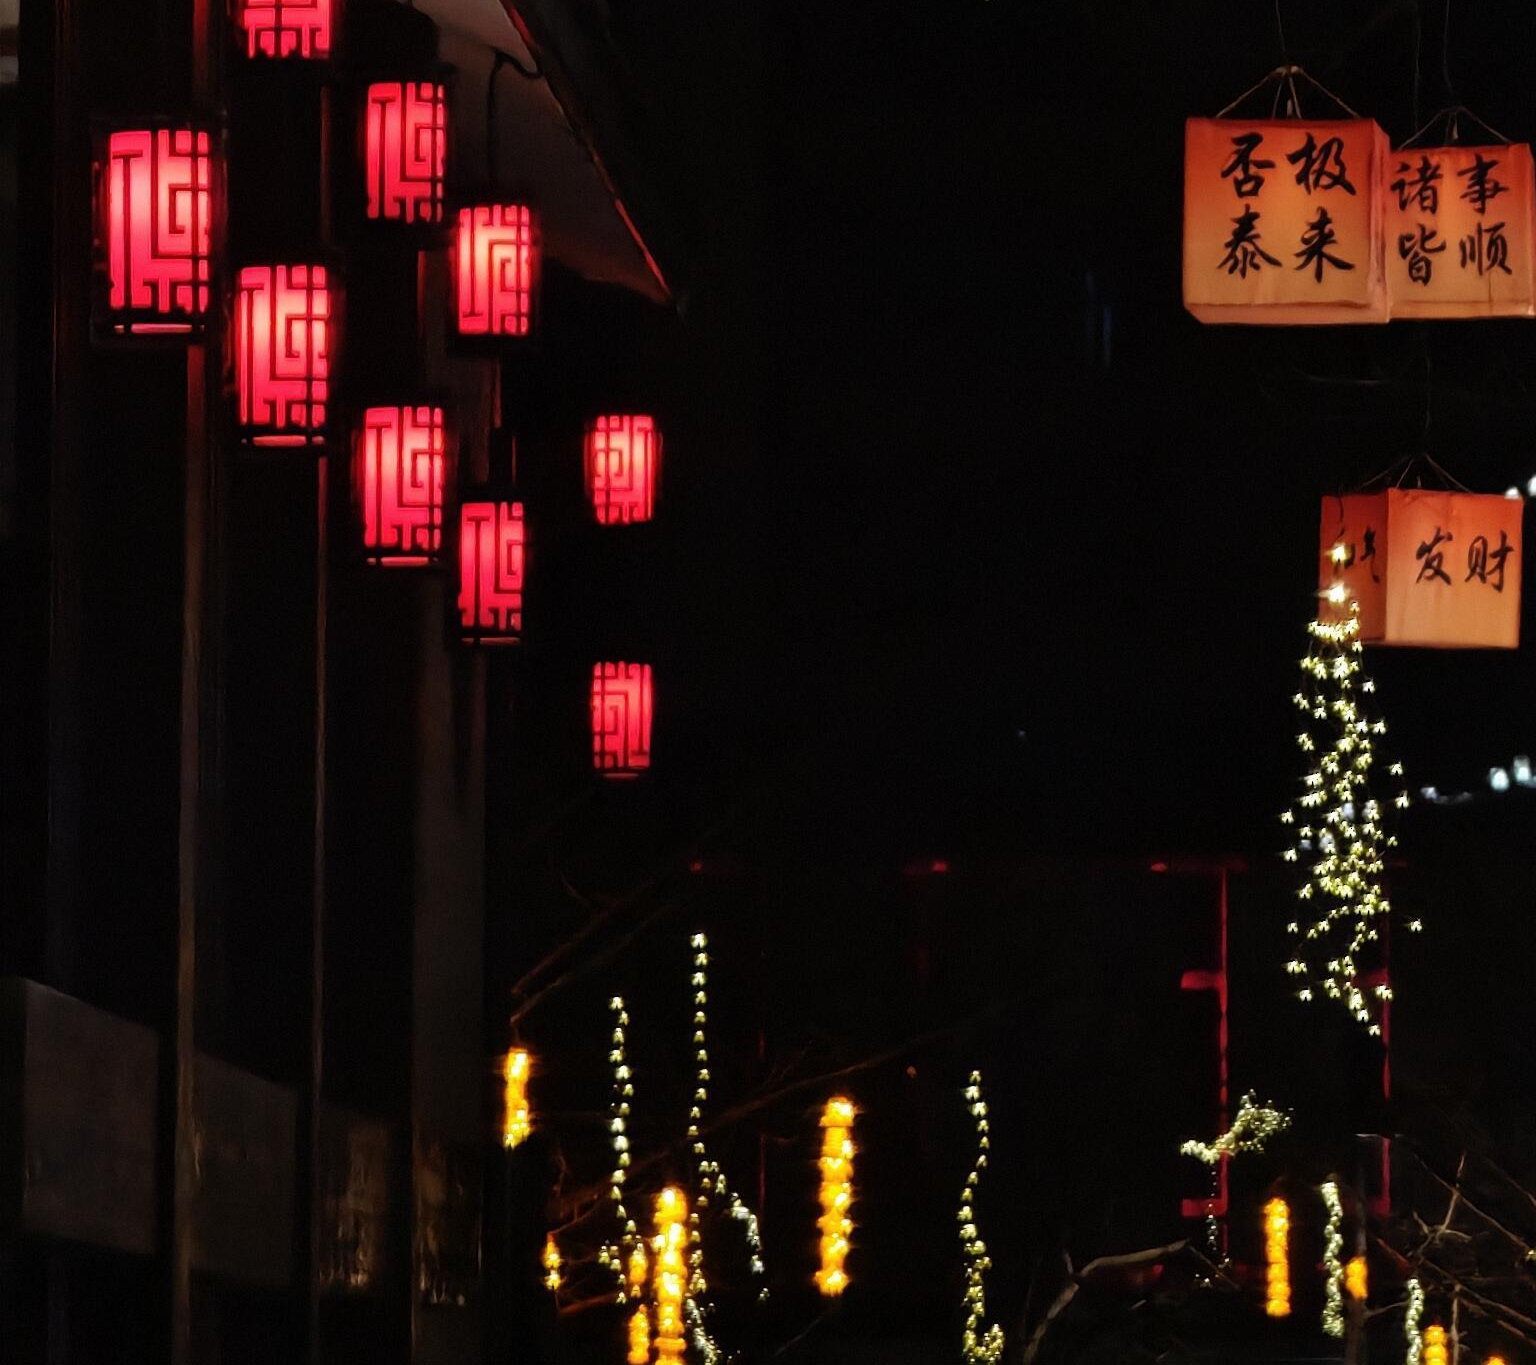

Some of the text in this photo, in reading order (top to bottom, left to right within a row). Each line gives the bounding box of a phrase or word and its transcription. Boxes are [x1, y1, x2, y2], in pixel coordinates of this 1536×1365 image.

[1219, 131, 1357, 198] 否极
[1390, 153, 1510, 215] 诸事
[1216, 203, 1356, 283] 泰来
[1399, 221, 1513, 287] 皆顺
[1415, 525, 1515, 593] 发财
